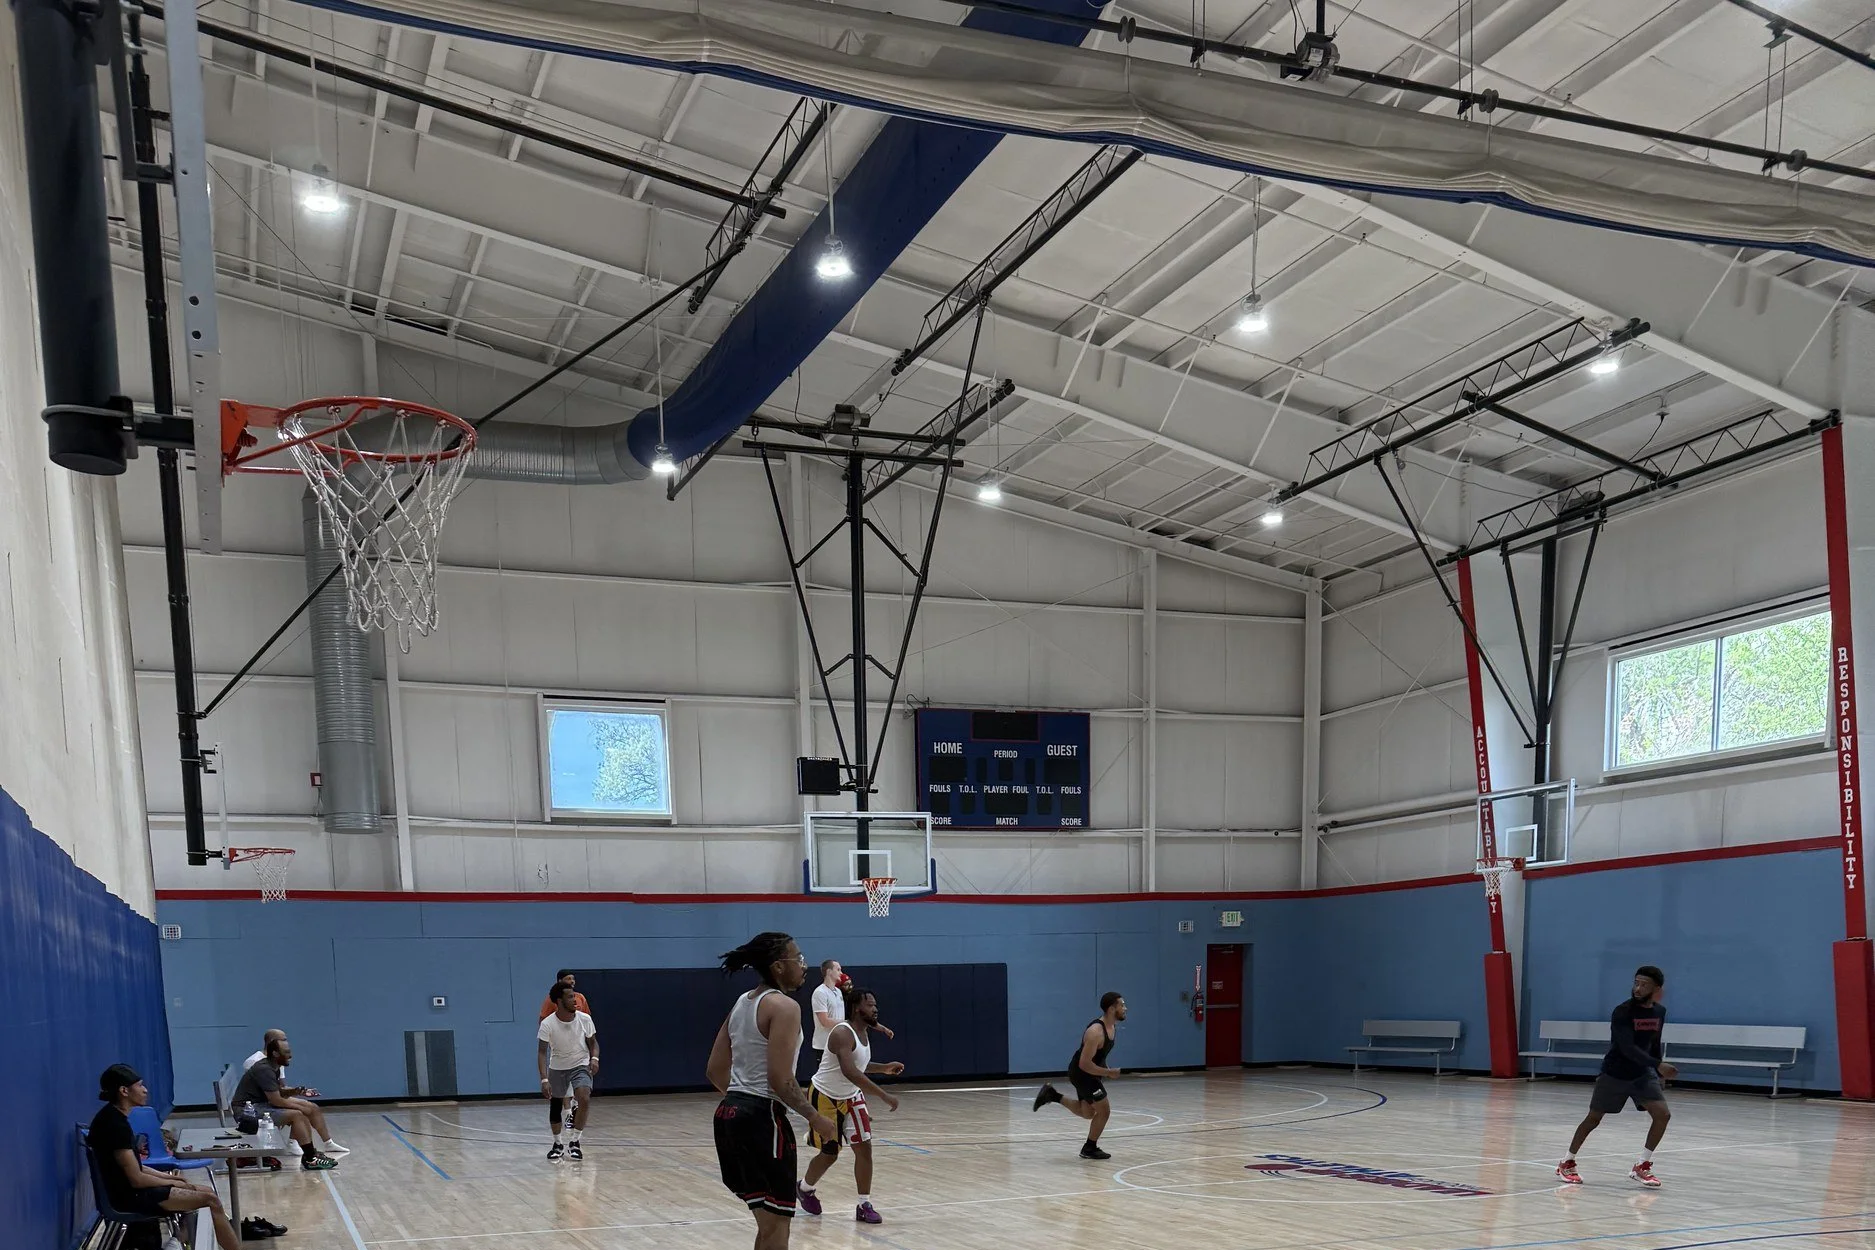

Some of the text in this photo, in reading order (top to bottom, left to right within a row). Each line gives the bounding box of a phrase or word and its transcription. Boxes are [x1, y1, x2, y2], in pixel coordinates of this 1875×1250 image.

[933, 742, 963, 754] HOME
[1047, 744, 1078, 757] GUEST
[993, 750, 1018, 758] PERIOD
[1838, 647, 1857, 888] RESPONSIBILITY
[929, 784, 951, 793] FOULS
[959, 785, 978, 793] T.O.L.
[983, 785, 1030, 794] PLAYER FOUL
[1036, 786, 1054, 794] T.O.L.
[1060, 786, 1082, 795] FOULS
[930, 816, 952, 825] SCORE
[995, 817, 1018, 825] MATCH
[1061, 817, 1082, 826] SCORE
